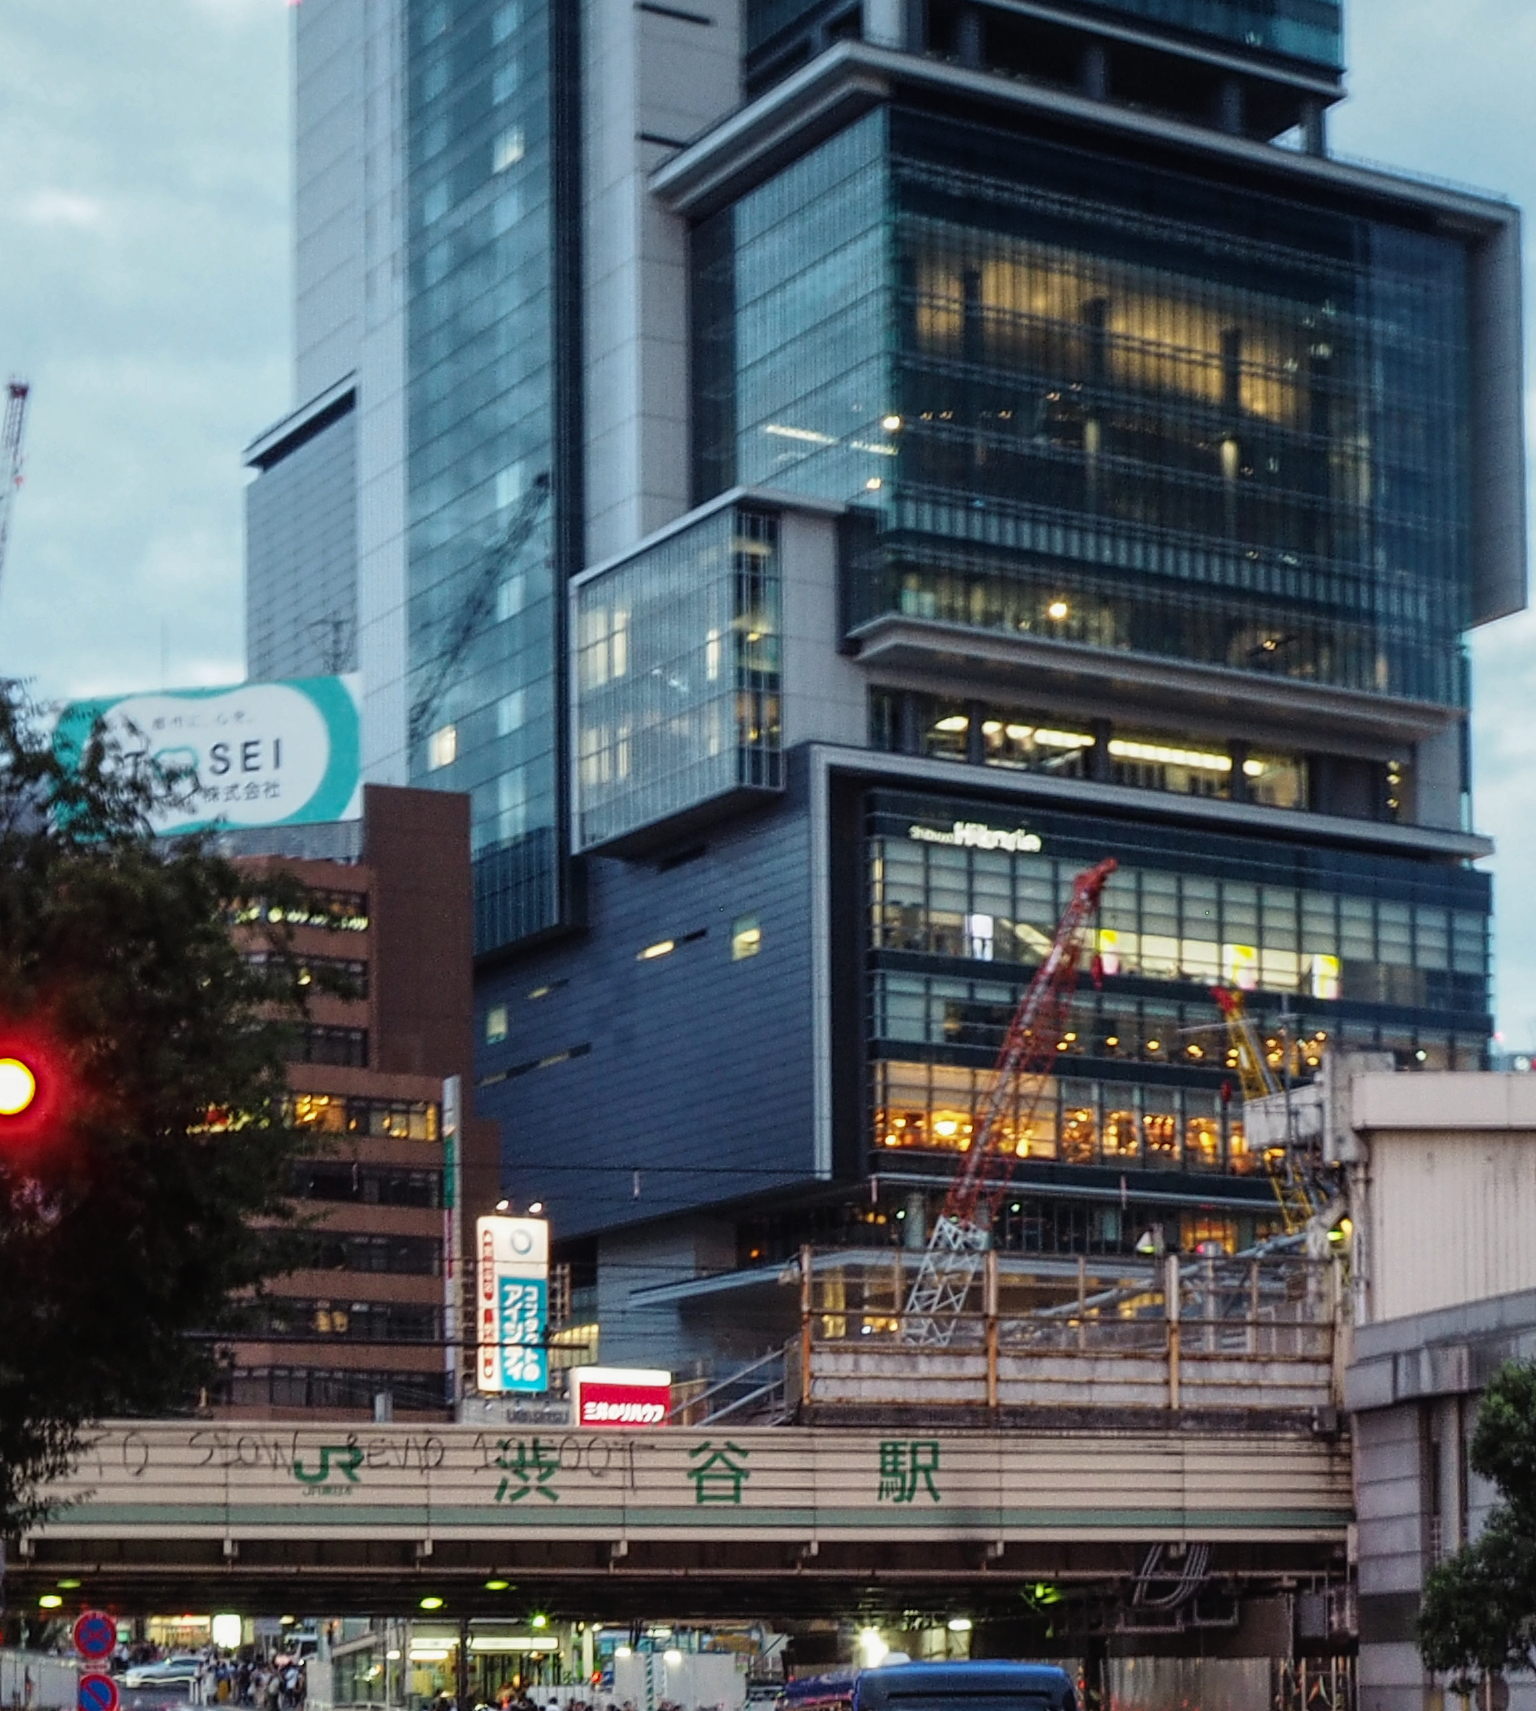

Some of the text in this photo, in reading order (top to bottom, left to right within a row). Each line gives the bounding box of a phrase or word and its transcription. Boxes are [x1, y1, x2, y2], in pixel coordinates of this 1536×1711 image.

[502, 1283, 525, 1382] アイシティ
[523, 1284, 541, 1383] コンタクトの
[293, 1444, 364, 1484] JR
